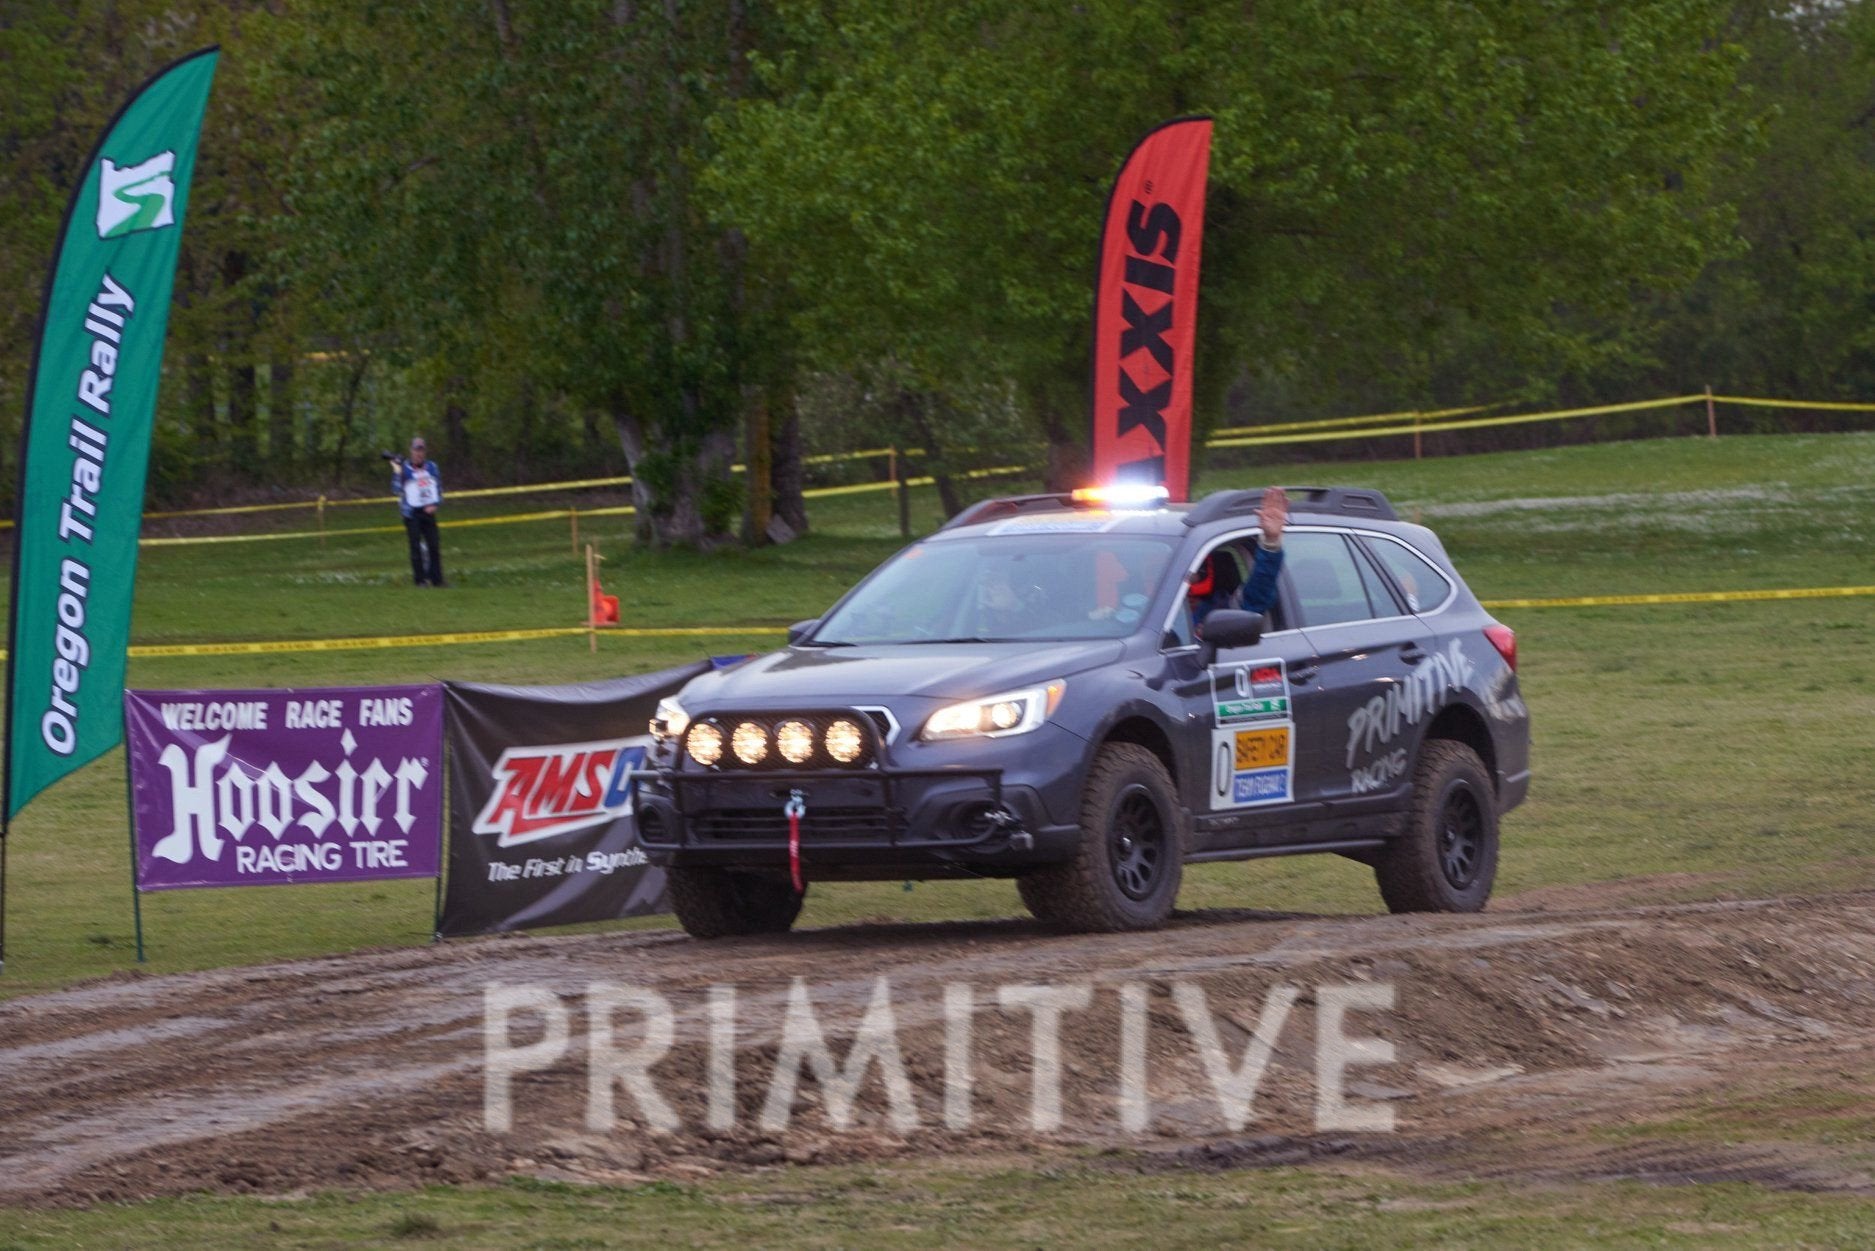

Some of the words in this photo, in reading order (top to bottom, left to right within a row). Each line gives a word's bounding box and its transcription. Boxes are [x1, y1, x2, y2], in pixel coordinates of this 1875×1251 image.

[77, 272, 135, 414] Rally
[59, 417, 108, 542] Trail
[41, 558, 91, 755] Oregon
[161, 701, 269, 731] WELCOME
[285, 699, 343, 730] RACE
[359, 697, 414, 728] FANS
[1347, 638, 1474, 768] PRIMITIVE
[152, 728, 430, 864] Hoosier
[1352, 748, 1407, 793] RACING
[236, 842, 343, 874] RACING
[349, 839, 409, 869] TIRE
[488, 861, 522, 882] The
[522, 858, 565, 879] First
[565, 854, 584, 874] in
